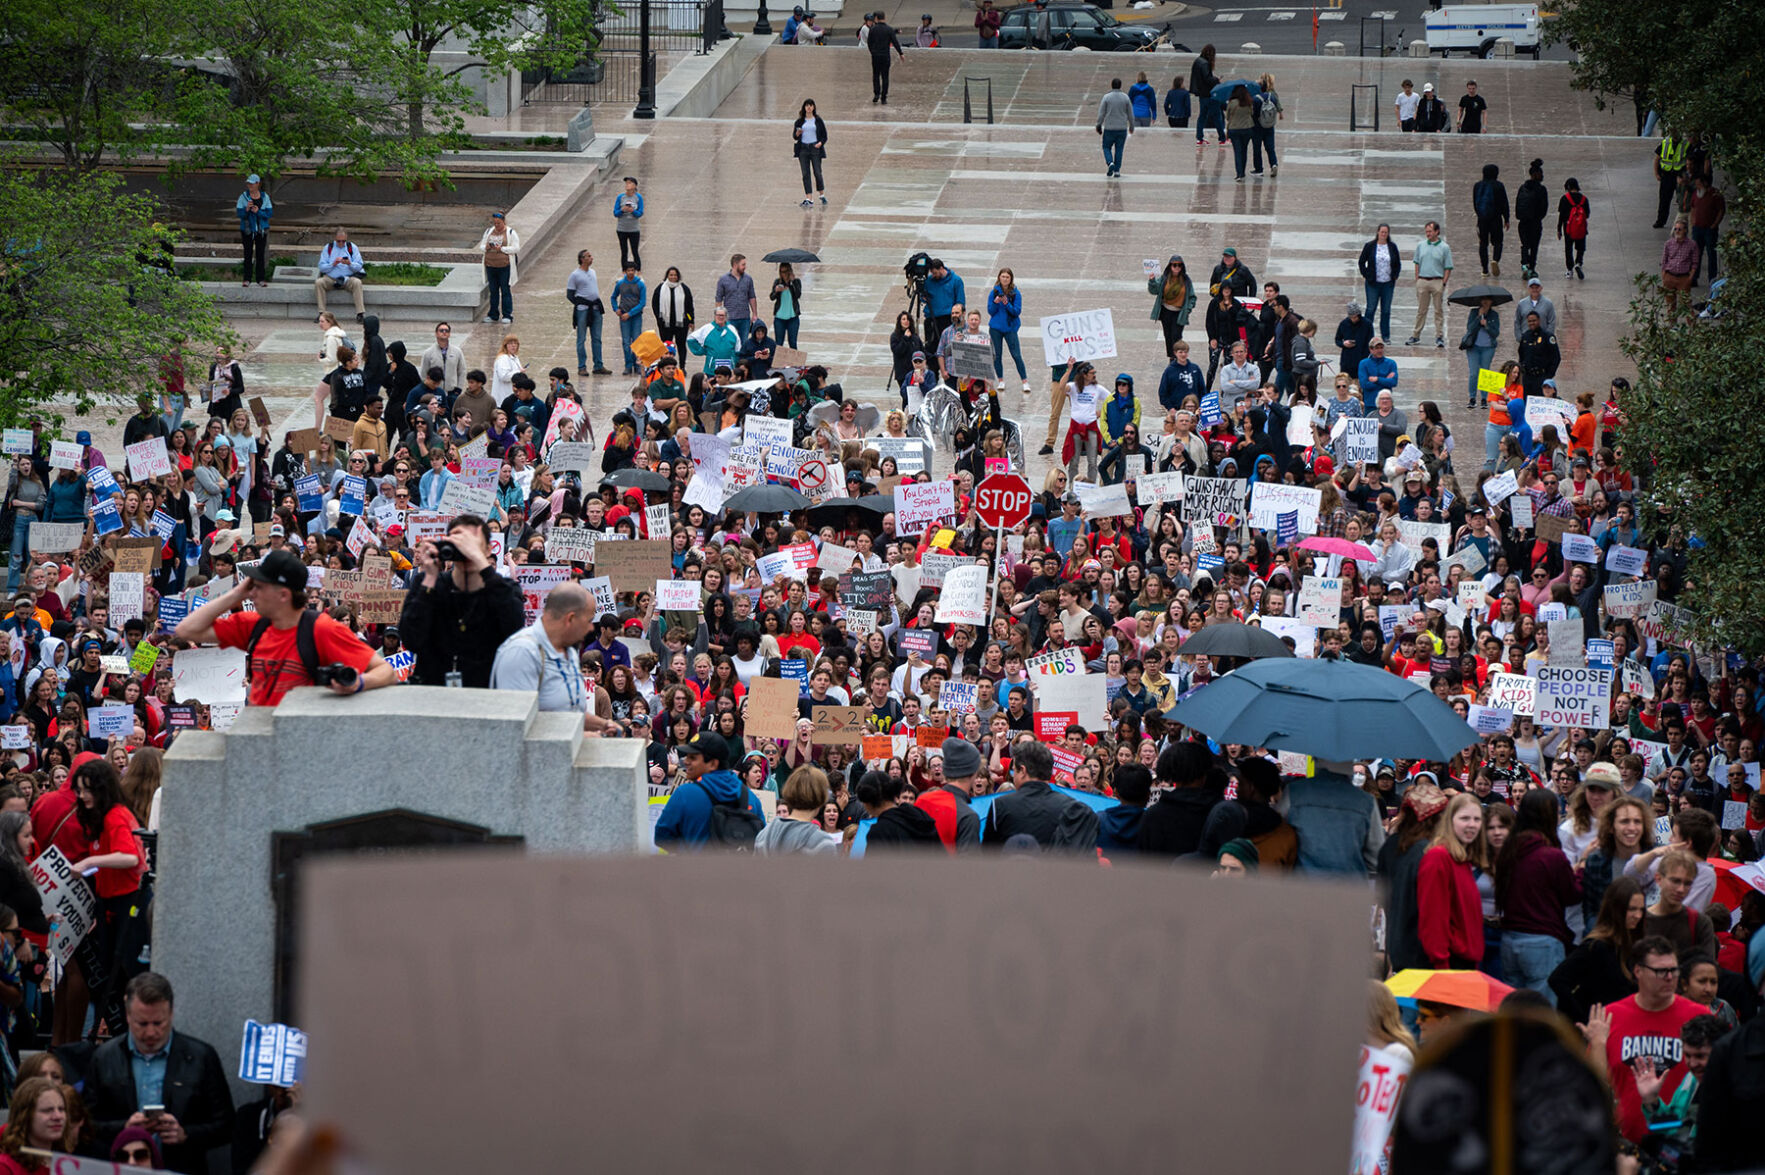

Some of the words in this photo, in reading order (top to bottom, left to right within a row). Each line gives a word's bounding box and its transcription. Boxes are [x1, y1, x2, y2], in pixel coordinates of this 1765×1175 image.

[1048, 311, 1105, 339] GUNS
[1064, 335, 1083, 344] KILL
[1054, 336, 1097, 361] KIDS
[1347, 419, 1378, 435] ENOUGH
[746, 431, 770, 441] POLICY
[772, 434, 787, 442] AND
[1359, 437, 1366, 446] IS
[128, 438, 162, 456] PROTECT
[140, 449, 157, 461] KIDS
[132, 463, 150, 476] NOT
[150, 458, 170, 470] GUNS
[466, 458, 498, 469] BOOKS
[103, 477, 115, 489] US
[303, 480, 318, 489] ENDS
[350, 481, 365, 490] ENDS
[1186, 477, 1214, 494] GUNS
[1214, 478, 1238, 496] HAVE
[354, 491, 364, 500] US
[804, 483, 827, 498] HERE
[902, 487, 917, 502] You
[918, 485, 938, 498] Can't
[939, 481, 951, 494] fix
[1254, 483, 1316, 506] CLASSROOM
[913, 495, 941, 508] Stupid
[978, 488, 1029, 512] STOP
[1184, 493, 1209, 511] MORE
[1210, 495, 1243, 515] RIGHTS
[102, 504, 116, 516] US
[899, 508, 917, 522] But
[919, 510, 933, 521] you
[937, 506, 953, 516] can
[1204, 511, 1215, 524] ME
[900, 520, 924, 534] VOTE
[1399, 523, 1450, 537] SCHOOL
[551, 527, 600, 541] THOUGHTS
[551, 539, 594, 549] PRAYERS
[1195, 542, 1216, 554] HANDS
[548, 547, 594, 562] ACTION
[1617, 553, 1641, 562] STUDENTS
[764, 560, 788, 568] STUDENTS
[329, 570, 363, 582] PROTECT
[367, 567, 389, 579] GUNS
[516, 575, 541, 584] STOP
[333, 580, 354, 590] KIDS
[1320, 580, 1338, 590] NRA
[1606, 584, 1638, 594] PROTECT
[1641, 582, 1654, 590] MY
[866, 592, 890, 604] GUNS
[1622, 593, 1642, 602] KIDS
[111, 604, 138, 614] SHOOTER
[373, 600, 401, 612] NOT
[1607, 605, 1622, 616] NOT
[847, 611, 873, 619] PROTECT
[850, 625, 871, 633] GUNS
[385, 651, 414, 669] BAN
[1027, 648, 1075, 668] PROTECT
[1601, 655, 1614, 664] US
[1040, 658, 1076, 675] KIDS
[1537, 668, 1609, 683] CHOOSE
[1629, 672, 1643, 684] THE
[944, 681, 977, 697] PUBLIC
[1496, 676, 1533, 689] PROTE
[1538, 681, 1607, 697] PEOPLE
[940, 692, 971, 704] HEALTH
[1500, 689, 1532, 702] KIDS
[1493, 699, 1516, 710] NOT
[1517, 702, 1535, 713] GU
[1554, 697, 1588, 710] NOT
[818, 710, 830, 724] 2
[847, 711, 860, 725] 2
[1478, 714, 1506, 723] STUDENTS
[30, 864, 59, 895] NOT
[43, 846, 92, 908] PROTECT
[56, 895, 86, 937] YOURS
[257, 1025, 277, 1061] ENDS
[1621, 1035, 1683, 1063] BANNED
[256, 1063, 273, 1080] IT
[283, 1056, 297, 1083] WITH
